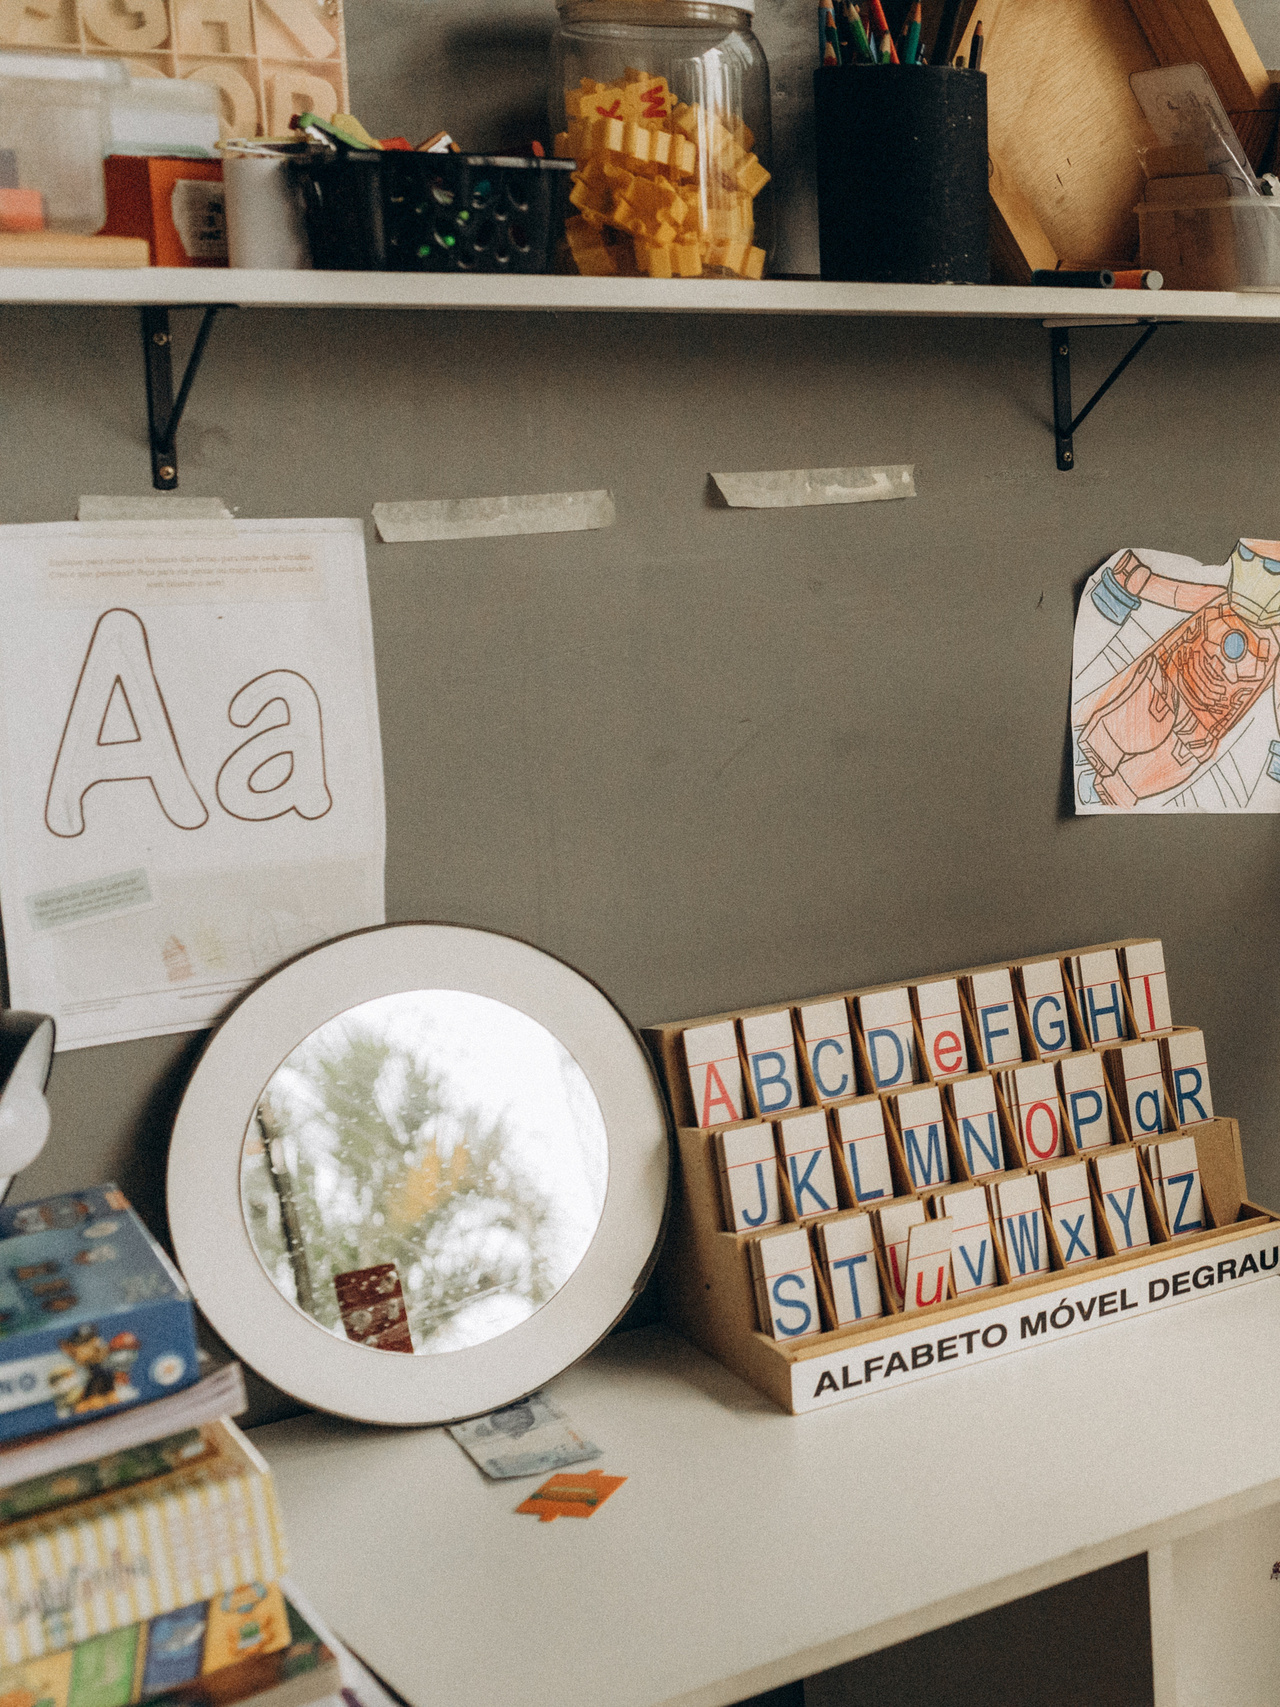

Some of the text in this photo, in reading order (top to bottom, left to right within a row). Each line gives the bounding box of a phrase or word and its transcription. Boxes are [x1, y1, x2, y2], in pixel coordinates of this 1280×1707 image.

[45, 607, 333, 838] Aa
[702, 1062, 740, 1128] A
[751, 1051, 792, 1113] B
[812, 1038, 849, 1097] C
[867, 1028, 905, 1088] D
[933, 1030, 963, 1072] e
[981, 1004, 1010, 1064] F
[1032, 995, 1067, 1050] G
[1086, 982, 1124, 1042] H
[741, 1163, 768, 1227] J
[789, 1149, 831, 1216] K
[848, 1142, 884, 1203] L
[904, 1123, 945, 1188] M
[961, 1113, 1001, 1175] N
[1025, 1102, 1059, 1159] O
[1070, 1089, 1103, 1149] P
[1173, 1067, 1209, 1125] R
[772, 1273, 812, 1336] S
[833, 1254, 868, 1319] T
[915, 1265, 945, 1308] u
[1006, 1211, 1040, 1276] W
[1106, 1187, 1137, 1248] Y
[1167, 1172, 1202, 1235] Z
[813, 1245, 1280, 1398] ALFABETO MÓVEL DEGRAU
